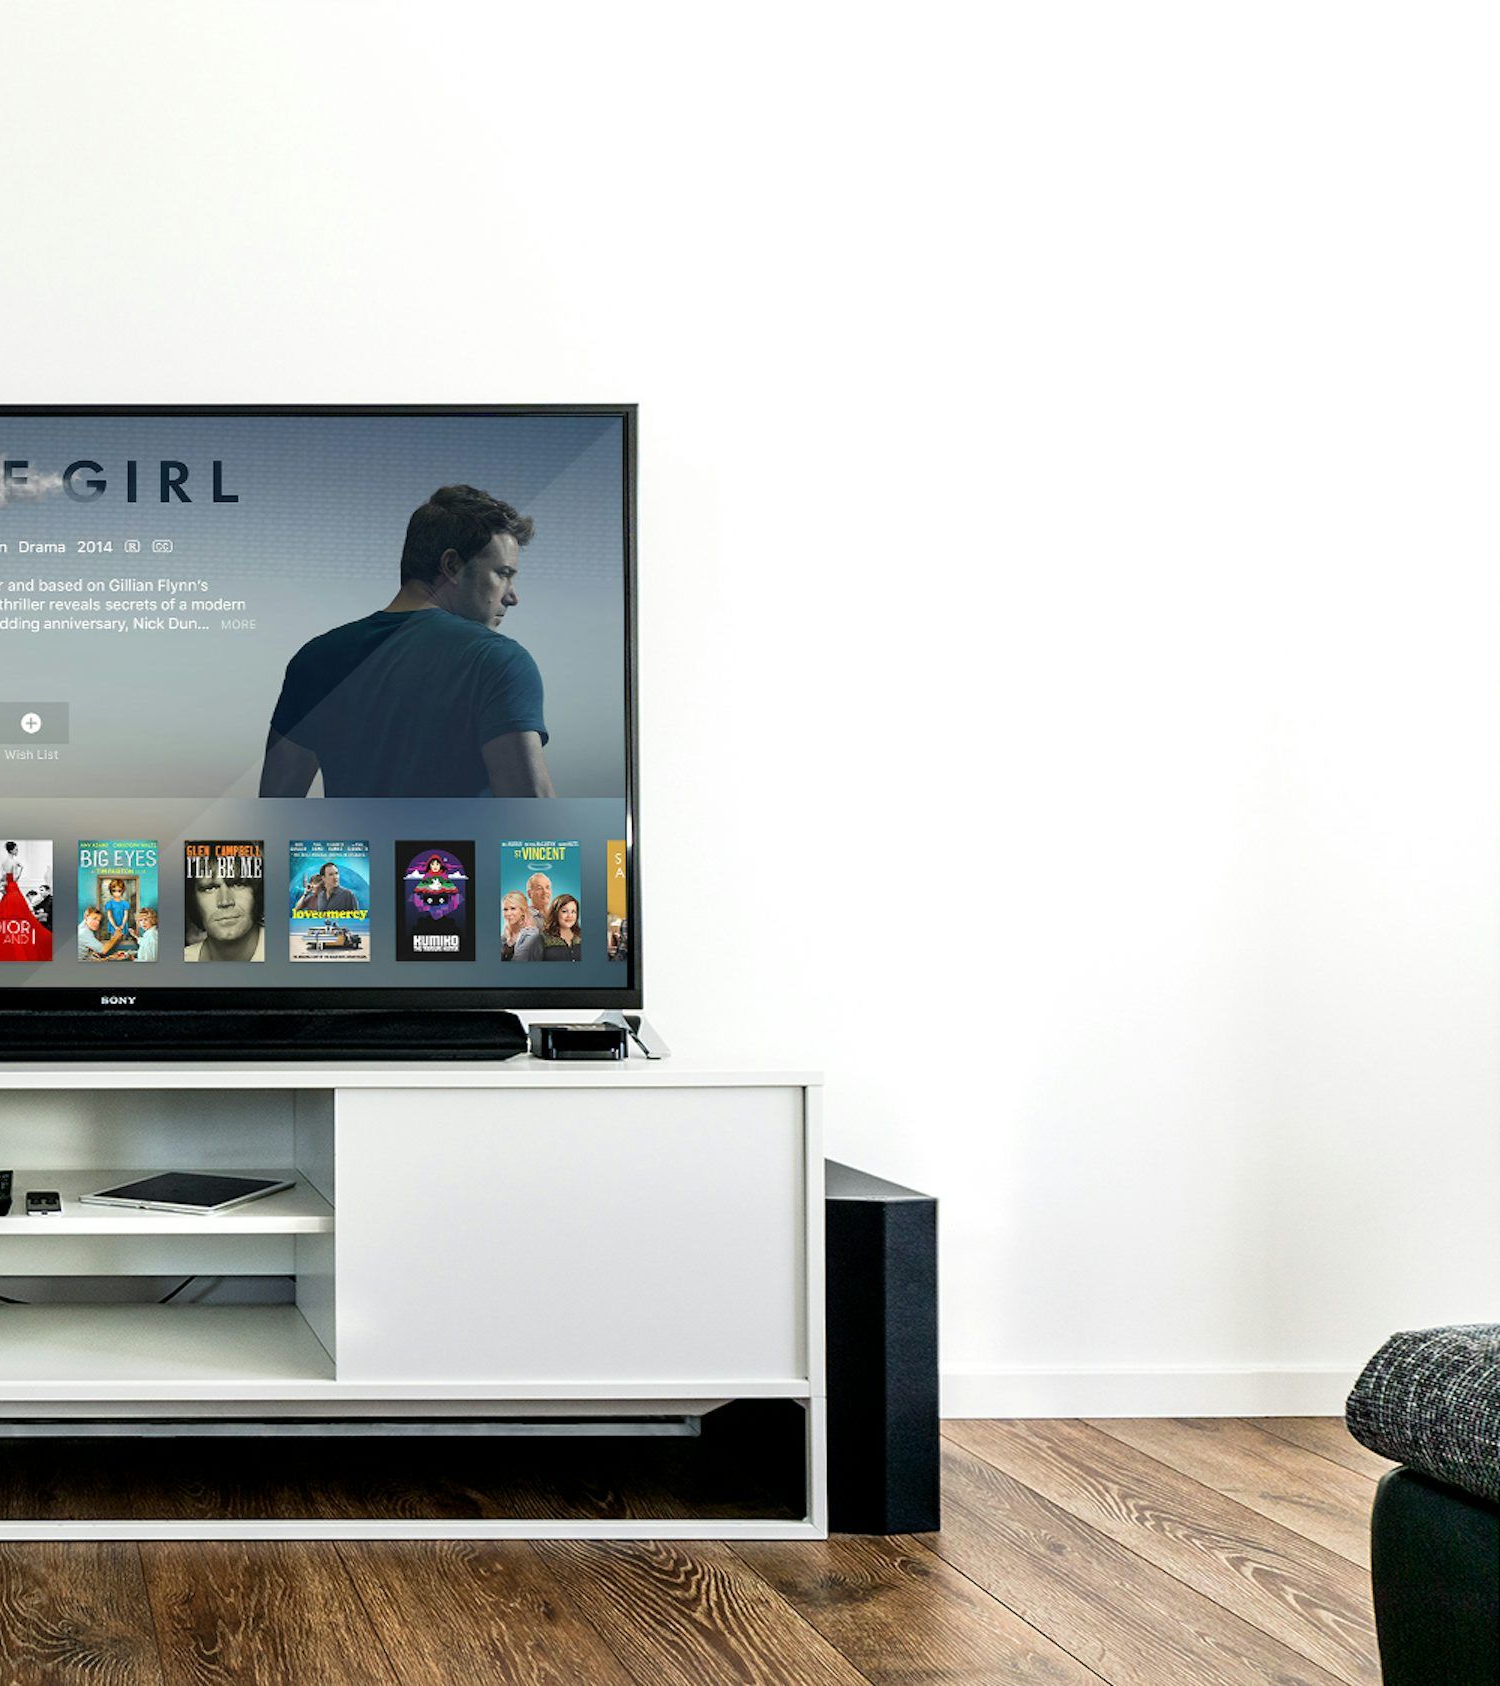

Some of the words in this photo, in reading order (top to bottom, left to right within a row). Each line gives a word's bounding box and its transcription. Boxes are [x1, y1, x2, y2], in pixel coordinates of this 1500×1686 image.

[62, 460, 240, 503] GIRL
[18, 541, 66, 553] Drama
[77, 541, 113, 553] 2014
[8, 579, 35, 592] and
[38, 579, 83, 592] based
[87, 582, 106, 592] on
[109, 579, 154, 592] Gillian
[158, 579, 209, 595] Flynn's
[49, 598, 101, 611] reveals
[105, 599, 157, 611] secrets
[161, 598, 176, 611] of
[179, 602, 187, 611] a
[191, 598, 246, 611] modern
[44, 617, 129, 633] anniversary,
[133, 617, 165, 630] Nick
[168, 617, 210, 630] Dun...
[221, 620, 257, 630] MORE
[3, 750, 34, 761] Wish
[37, 750, 60, 761] List
[186, 845, 210, 857] GLEN
[215, 845, 261, 857] CAMPBELL
[521, 847, 566, 860] VINCENT
[80, 850, 109, 867] BIG
[114, 850, 157, 867] EYES
[186, 857, 213, 879] I'LL
[217, 857, 235, 879] BE
[240, 857, 263, 879] ME
[3, 934, 30, 945] AND
[413, 935, 459, 946] KUMIKO
[101, 996, 137, 1005] SONY
